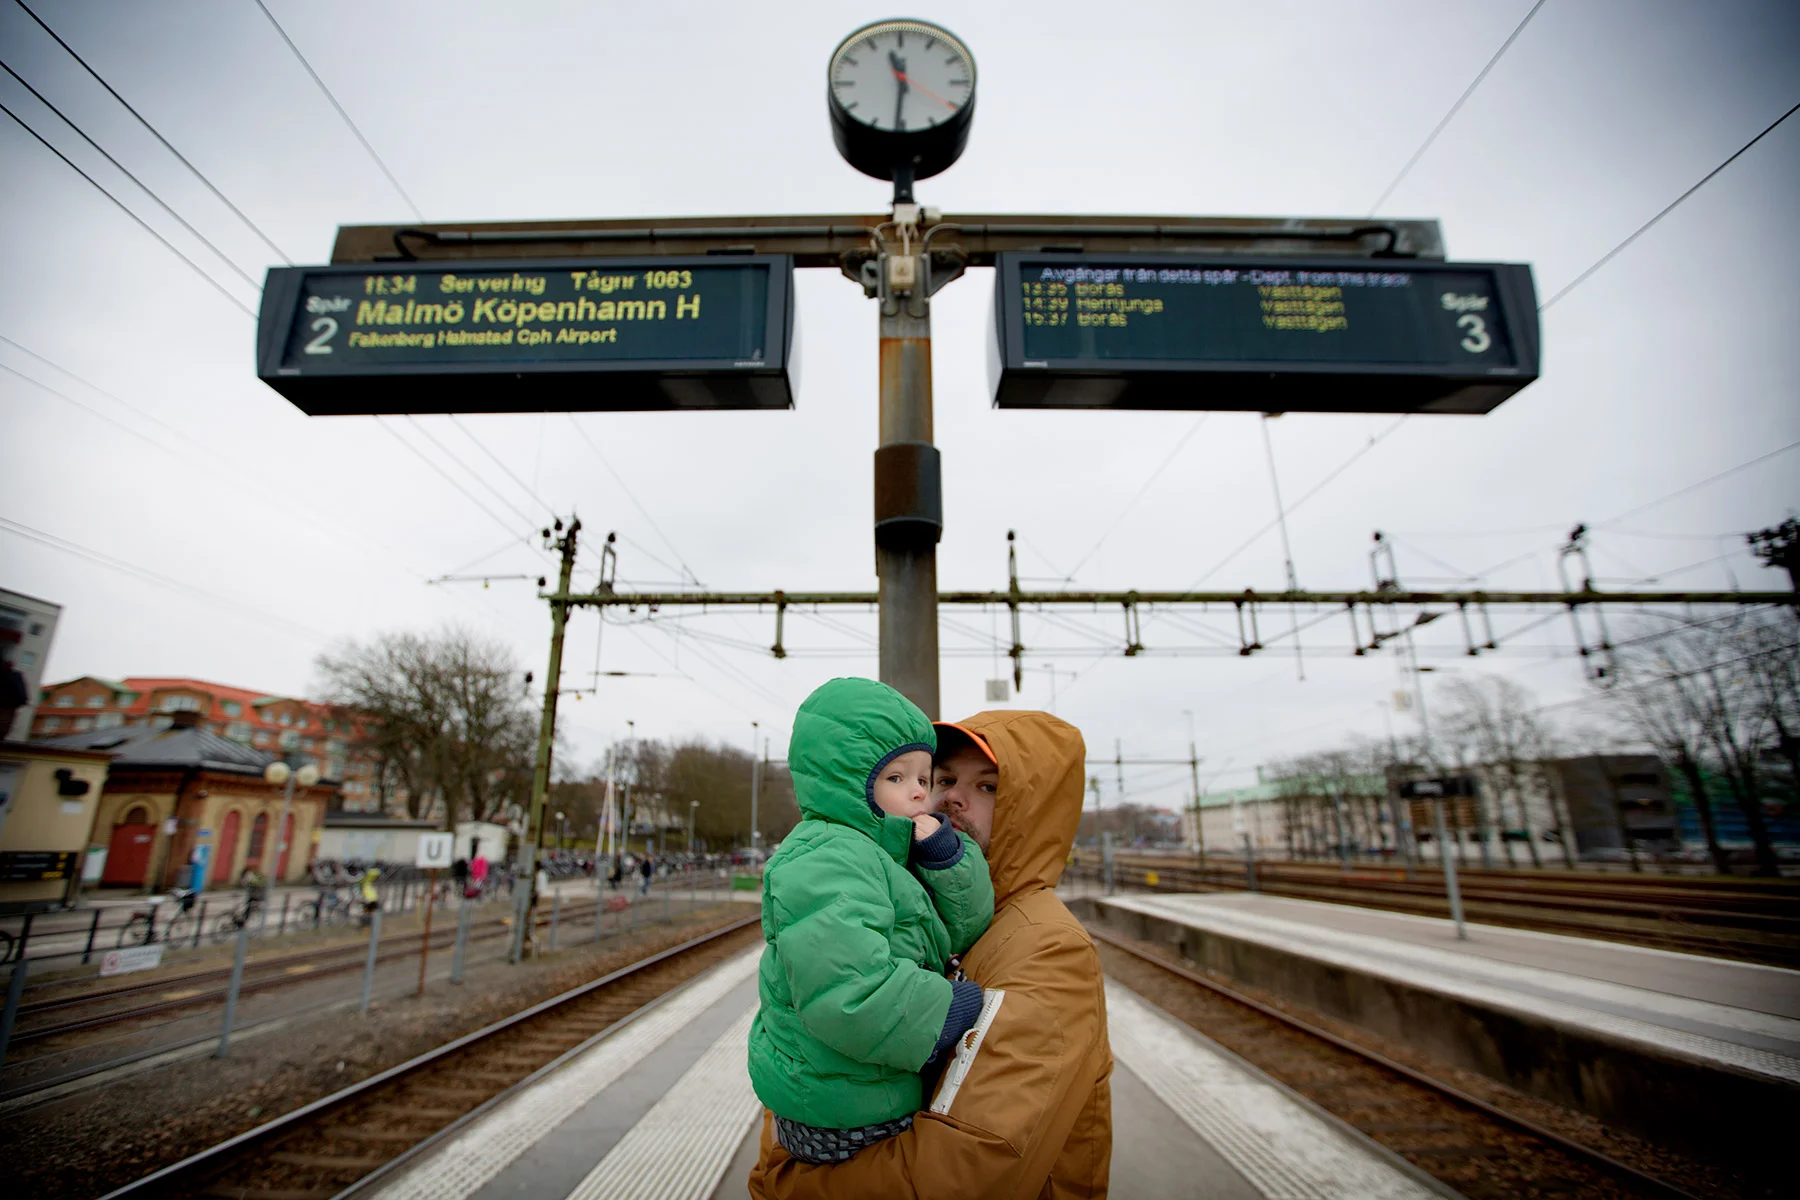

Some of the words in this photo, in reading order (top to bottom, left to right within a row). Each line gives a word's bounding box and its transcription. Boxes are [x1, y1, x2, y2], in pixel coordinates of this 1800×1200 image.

[365, 274, 418, 294] 11:34
[439, 273, 547, 295] Servering
[570, 270, 638, 294] Tågnr
[643, 270, 693, 289] 1063
[1040, 268, 1120, 285] Avgångar
[1122, 268, 1158, 284] från
[356, 299, 465, 326] Malmö
[472, 295, 667, 328] Köpenhamn
[676, 294, 701, 320] H
[304, 317, 338, 354] 2
[349, 331, 436, 349] Falkenberg
[437, 329, 514, 346] Halmstad
[516, 328, 552, 347] Cph
[555, 327, 618, 345] Airport
[1456, 313, 1491, 353] 3
[427, 839, 443, 861] U
